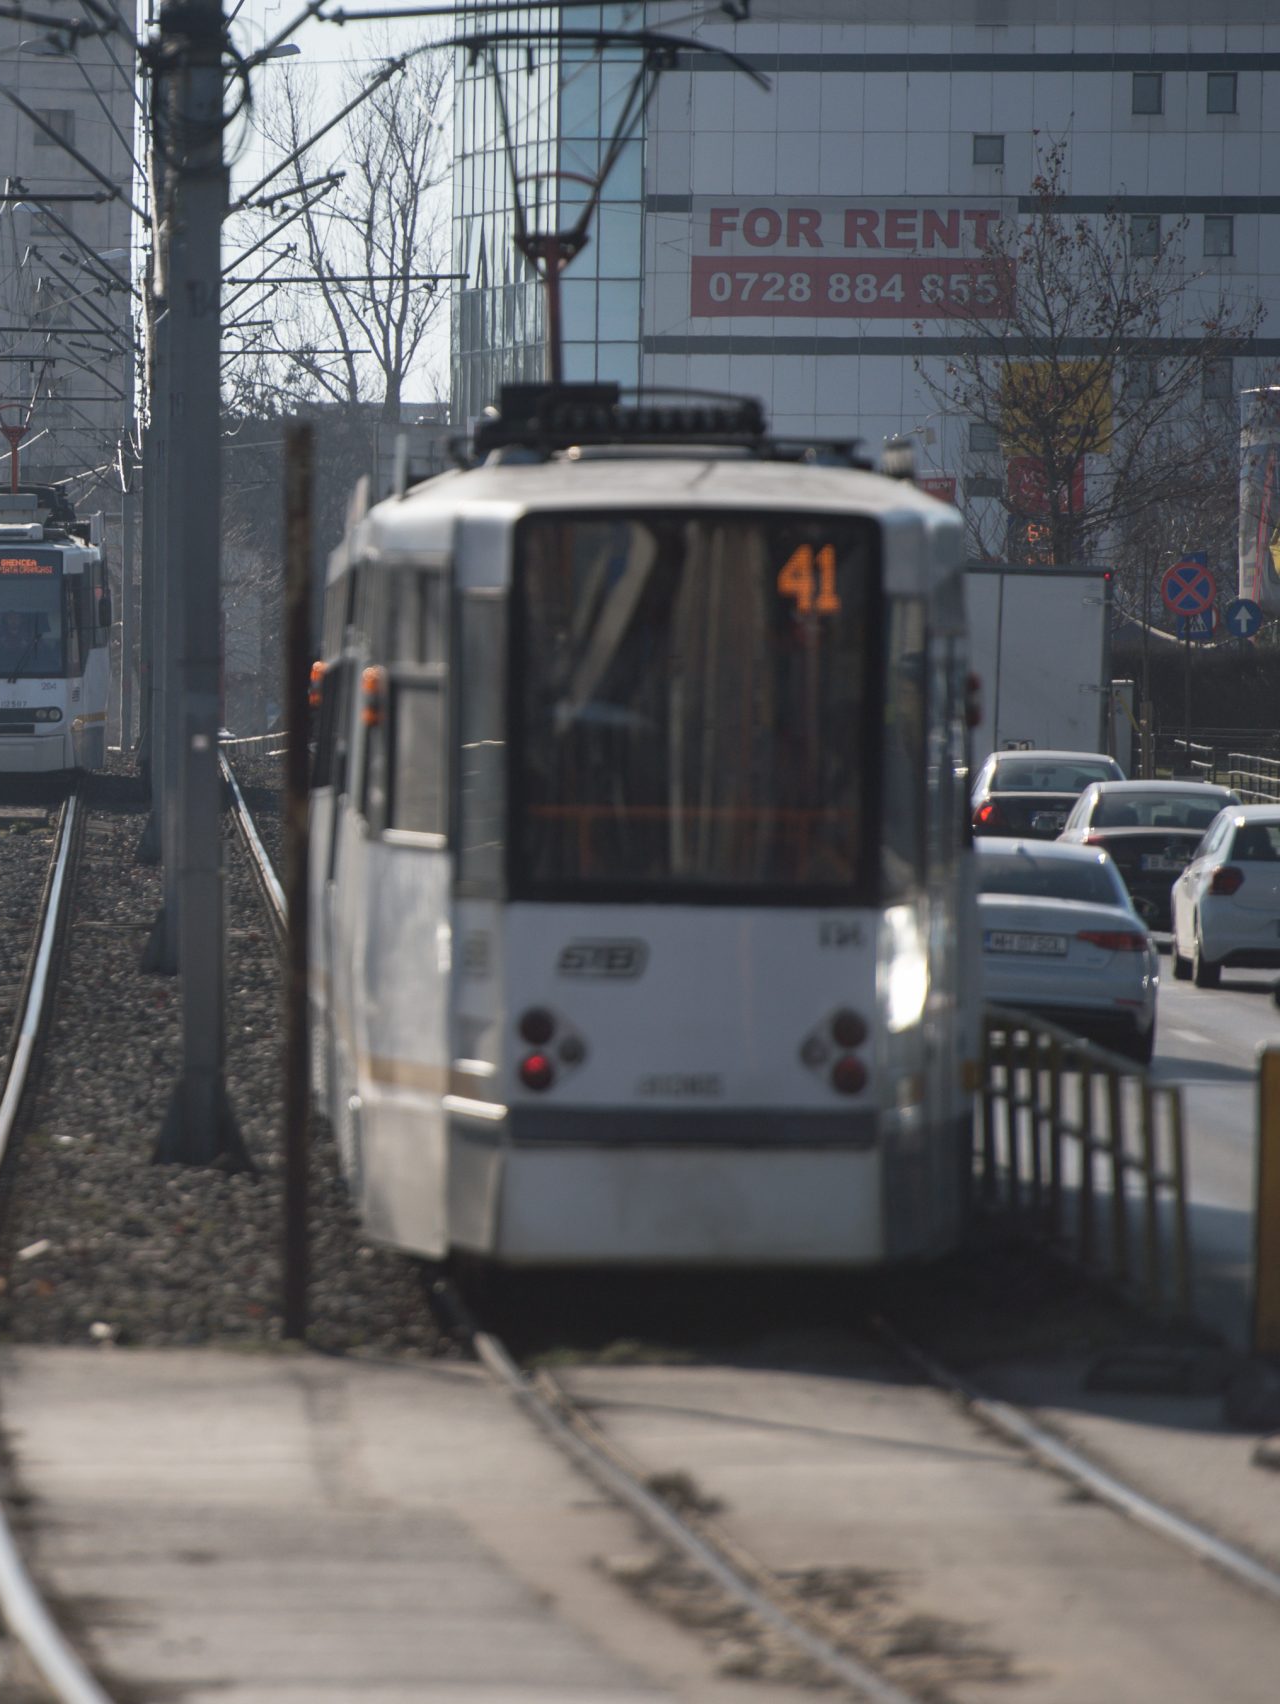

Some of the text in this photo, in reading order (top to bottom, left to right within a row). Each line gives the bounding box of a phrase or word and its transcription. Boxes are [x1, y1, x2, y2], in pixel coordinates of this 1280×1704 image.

[709, 207, 1001, 250] FOR RENT
[708, 272, 812, 303] 0728
[827, 272, 906, 304] 884
[777, 544, 841, 613] 41
